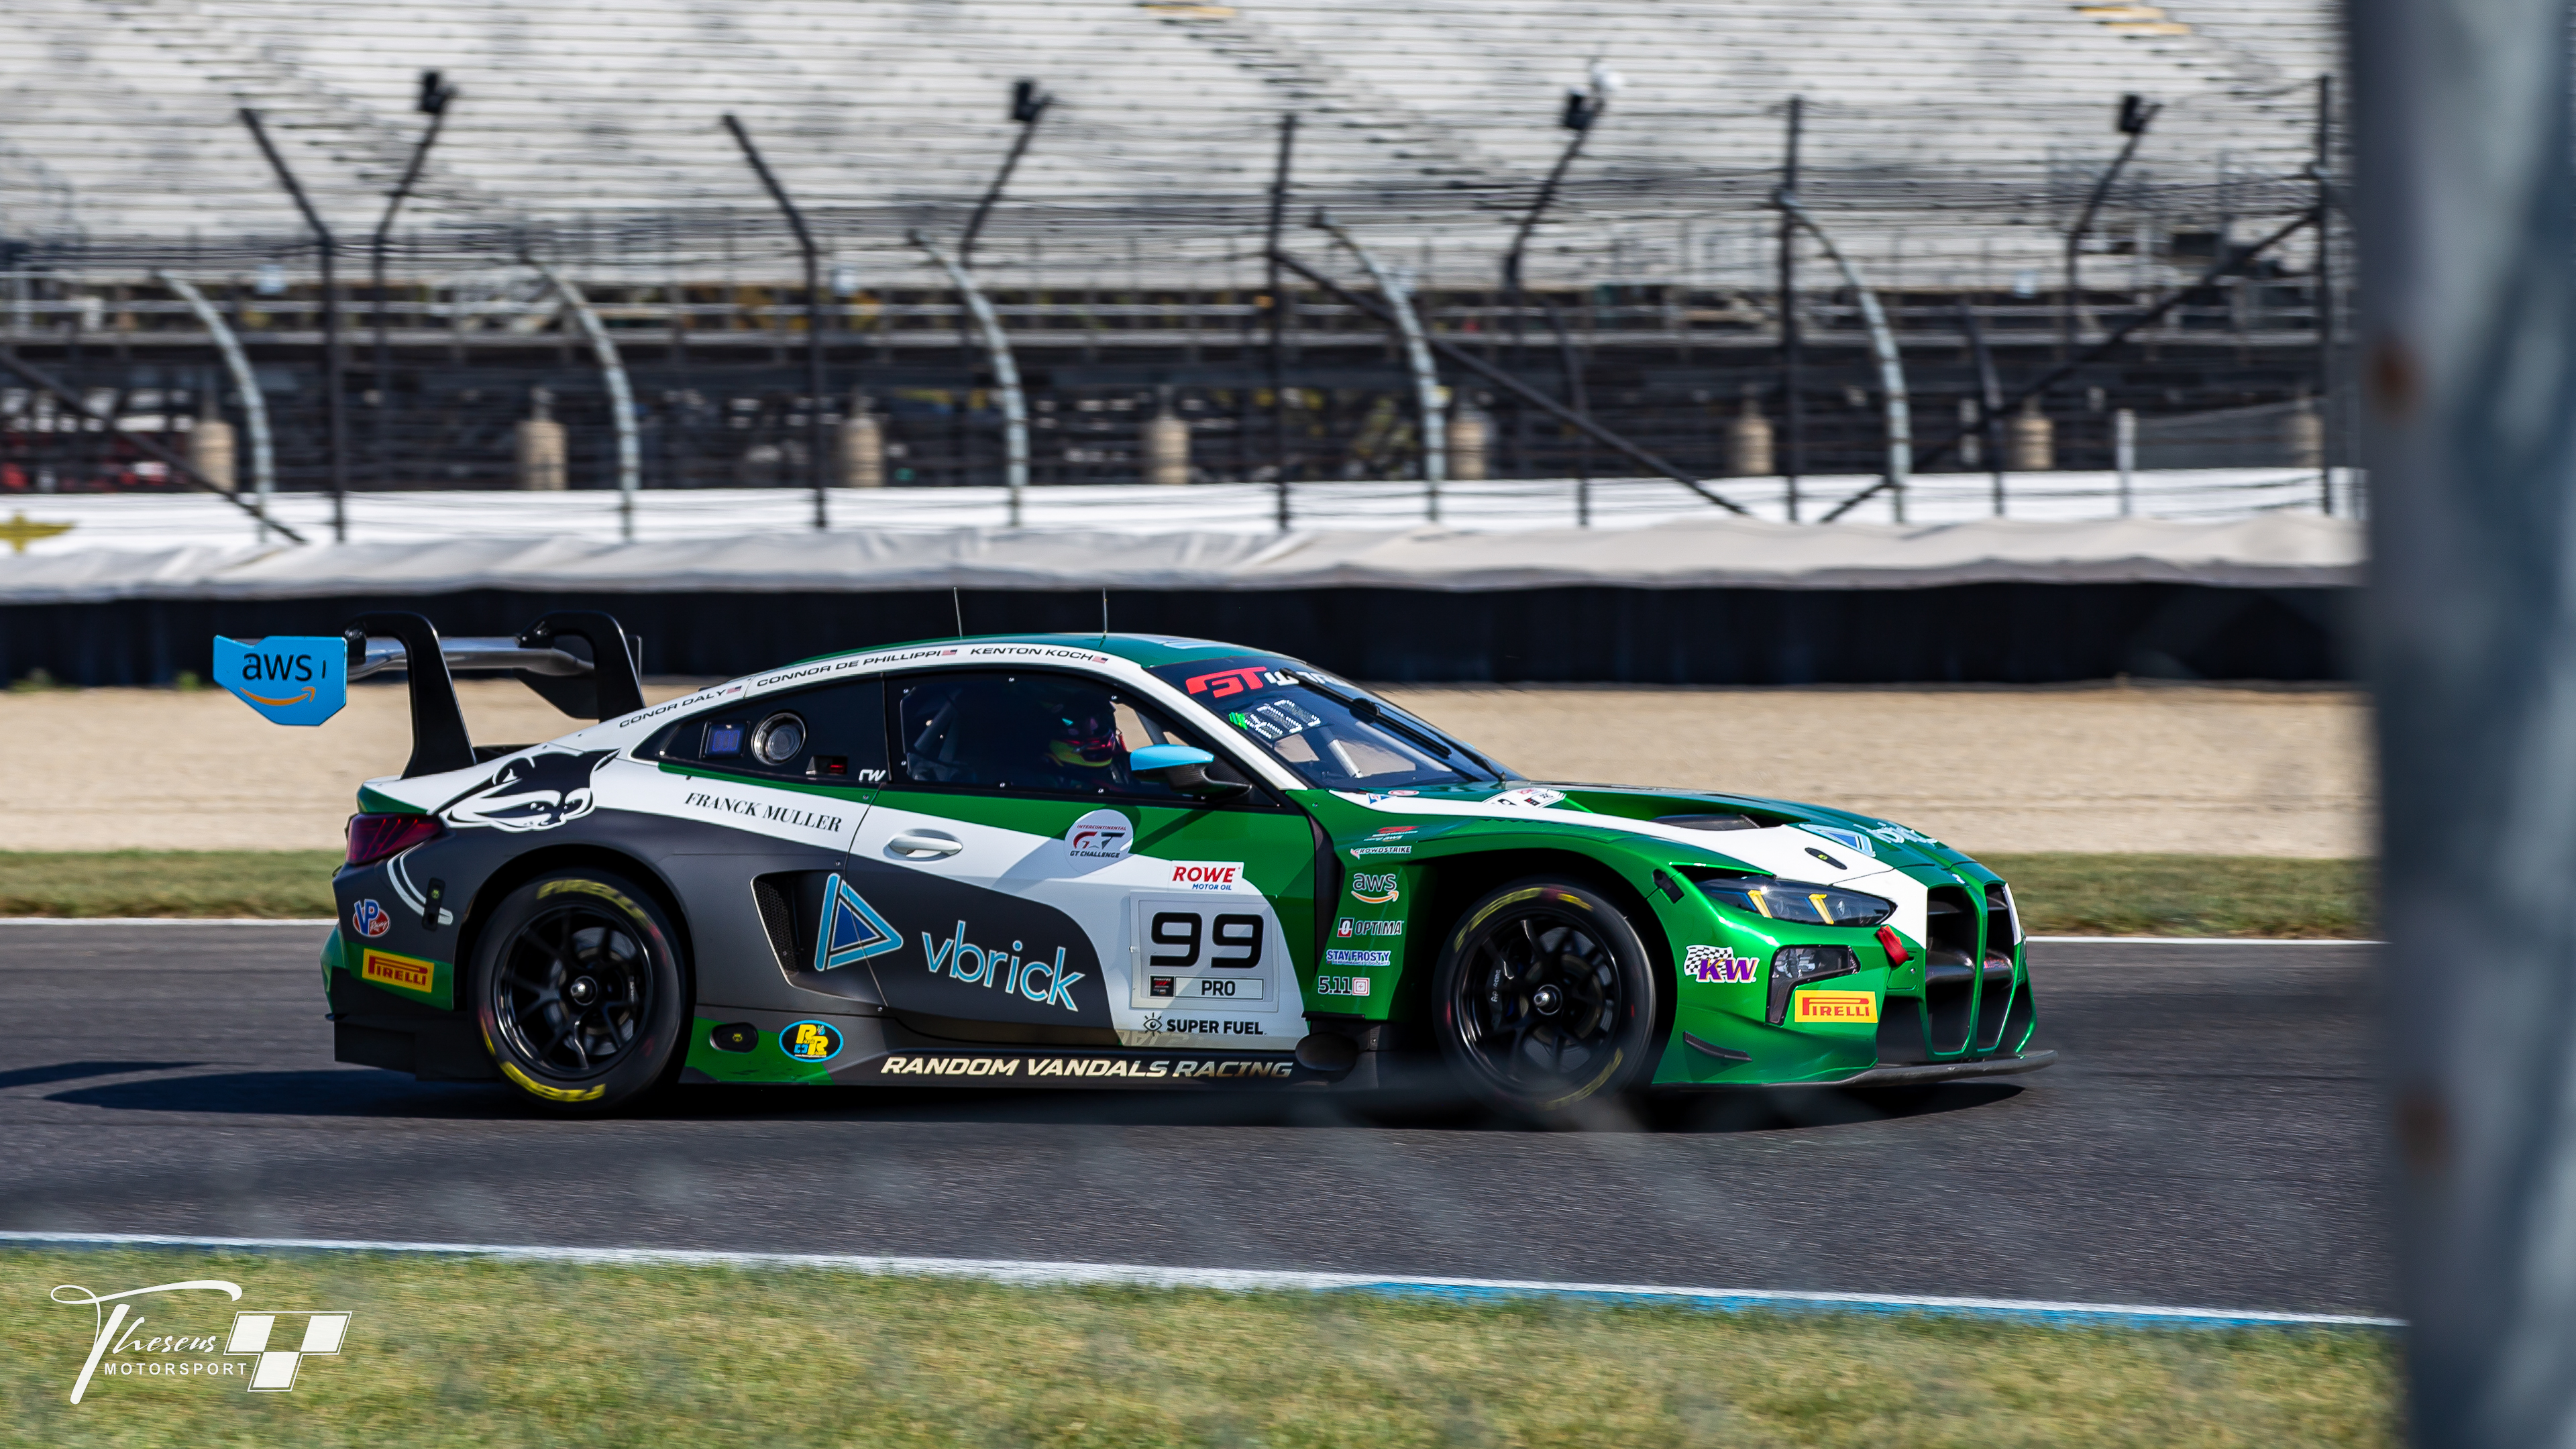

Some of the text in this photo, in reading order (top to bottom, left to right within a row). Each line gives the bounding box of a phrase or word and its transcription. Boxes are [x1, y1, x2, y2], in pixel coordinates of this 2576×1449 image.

[970, 647, 1094, 661] KENTON KOCH
[242, 653, 312, 681] aws
[757, 650, 941, 687] CONNOR DE PHILLIPPI
[1185, 666, 1267, 698] GT
[619, 689, 727, 729] CONOR DALY
[684, 792, 842, 833] FRANCK MULLER
[1172, 866, 1236, 883] ROWE
[1352, 873, 1397, 892] aws
[354, 899, 379, 936] VP
[1355, 921, 1402, 935] OPTIMA
[1149, 912, 1264, 969] 99
[922, 920, 1085, 1012] vbrick
[1327, 950, 1390, 961] STAY FROSTY
[368, 955, 428, 986] PIRELLI
[1698, 959, 1758, 980] KW
[1201, 980, 1236, 996] PRO
[1319, 976, 1350, 994] 5.11
[1802, 997, 1870, 1016] PIRELLI
[1167, 1018, 1264, 1035] SUPER FUEL
[880, 1057, 1293, 1078] RANDOM VANDALS RACING
